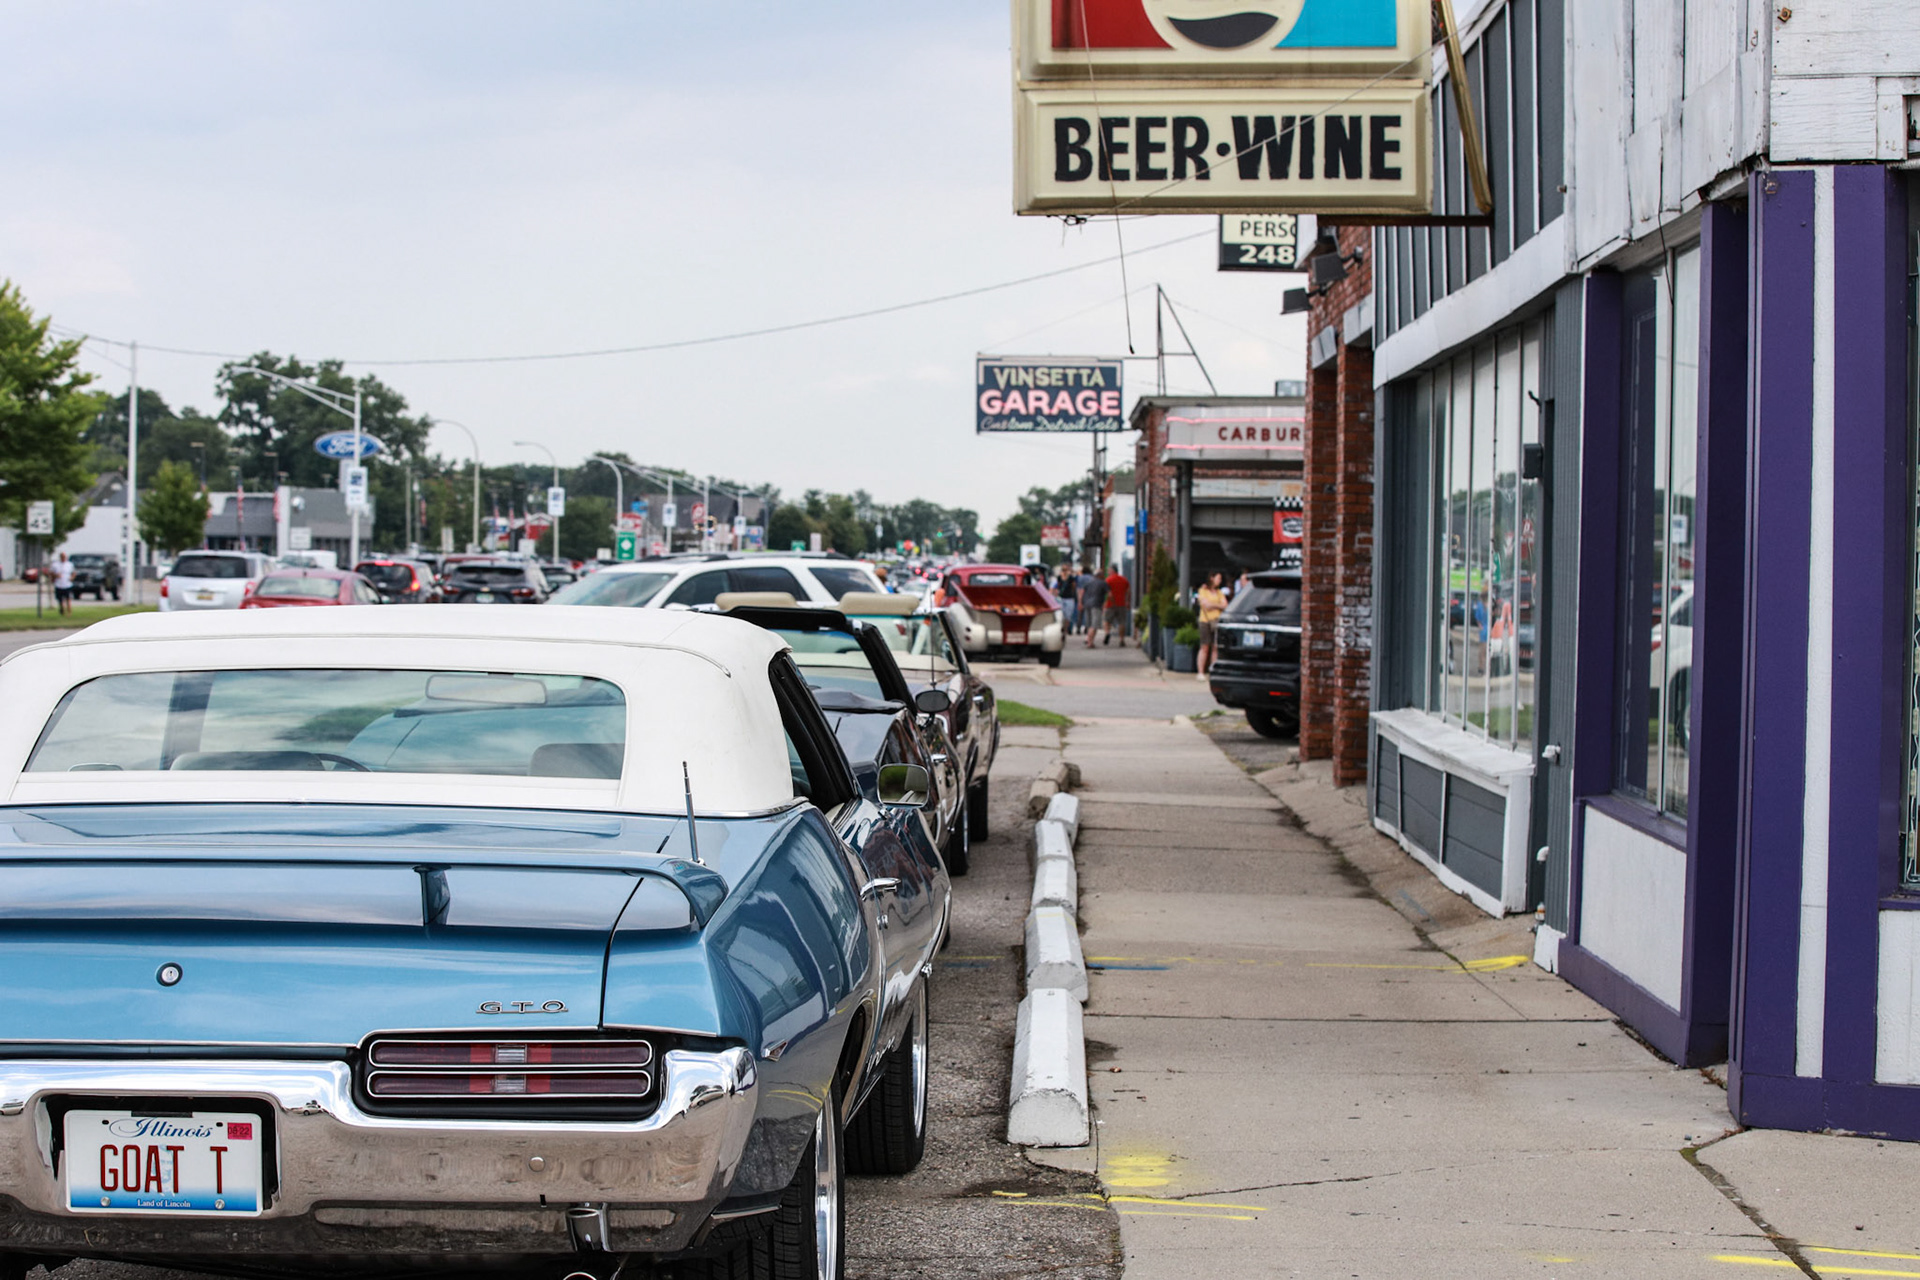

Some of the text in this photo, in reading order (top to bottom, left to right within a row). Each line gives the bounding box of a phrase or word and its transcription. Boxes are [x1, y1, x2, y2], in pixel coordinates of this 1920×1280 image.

[1239, 245, 1295, 264] 248
[993, 367, 1105, 390] VINSETTA
[980, 389, 1120, 416] GARAGE
[1218, 426, 1301, 441] CARBUR
[479, 1000, 565, 1014] GTO
[109, 1117, 213, 1138] Illinois
[100, 1144, 228, 1194] GOAT T
[137, 1199, 191, 1208] Land of Lincoln
